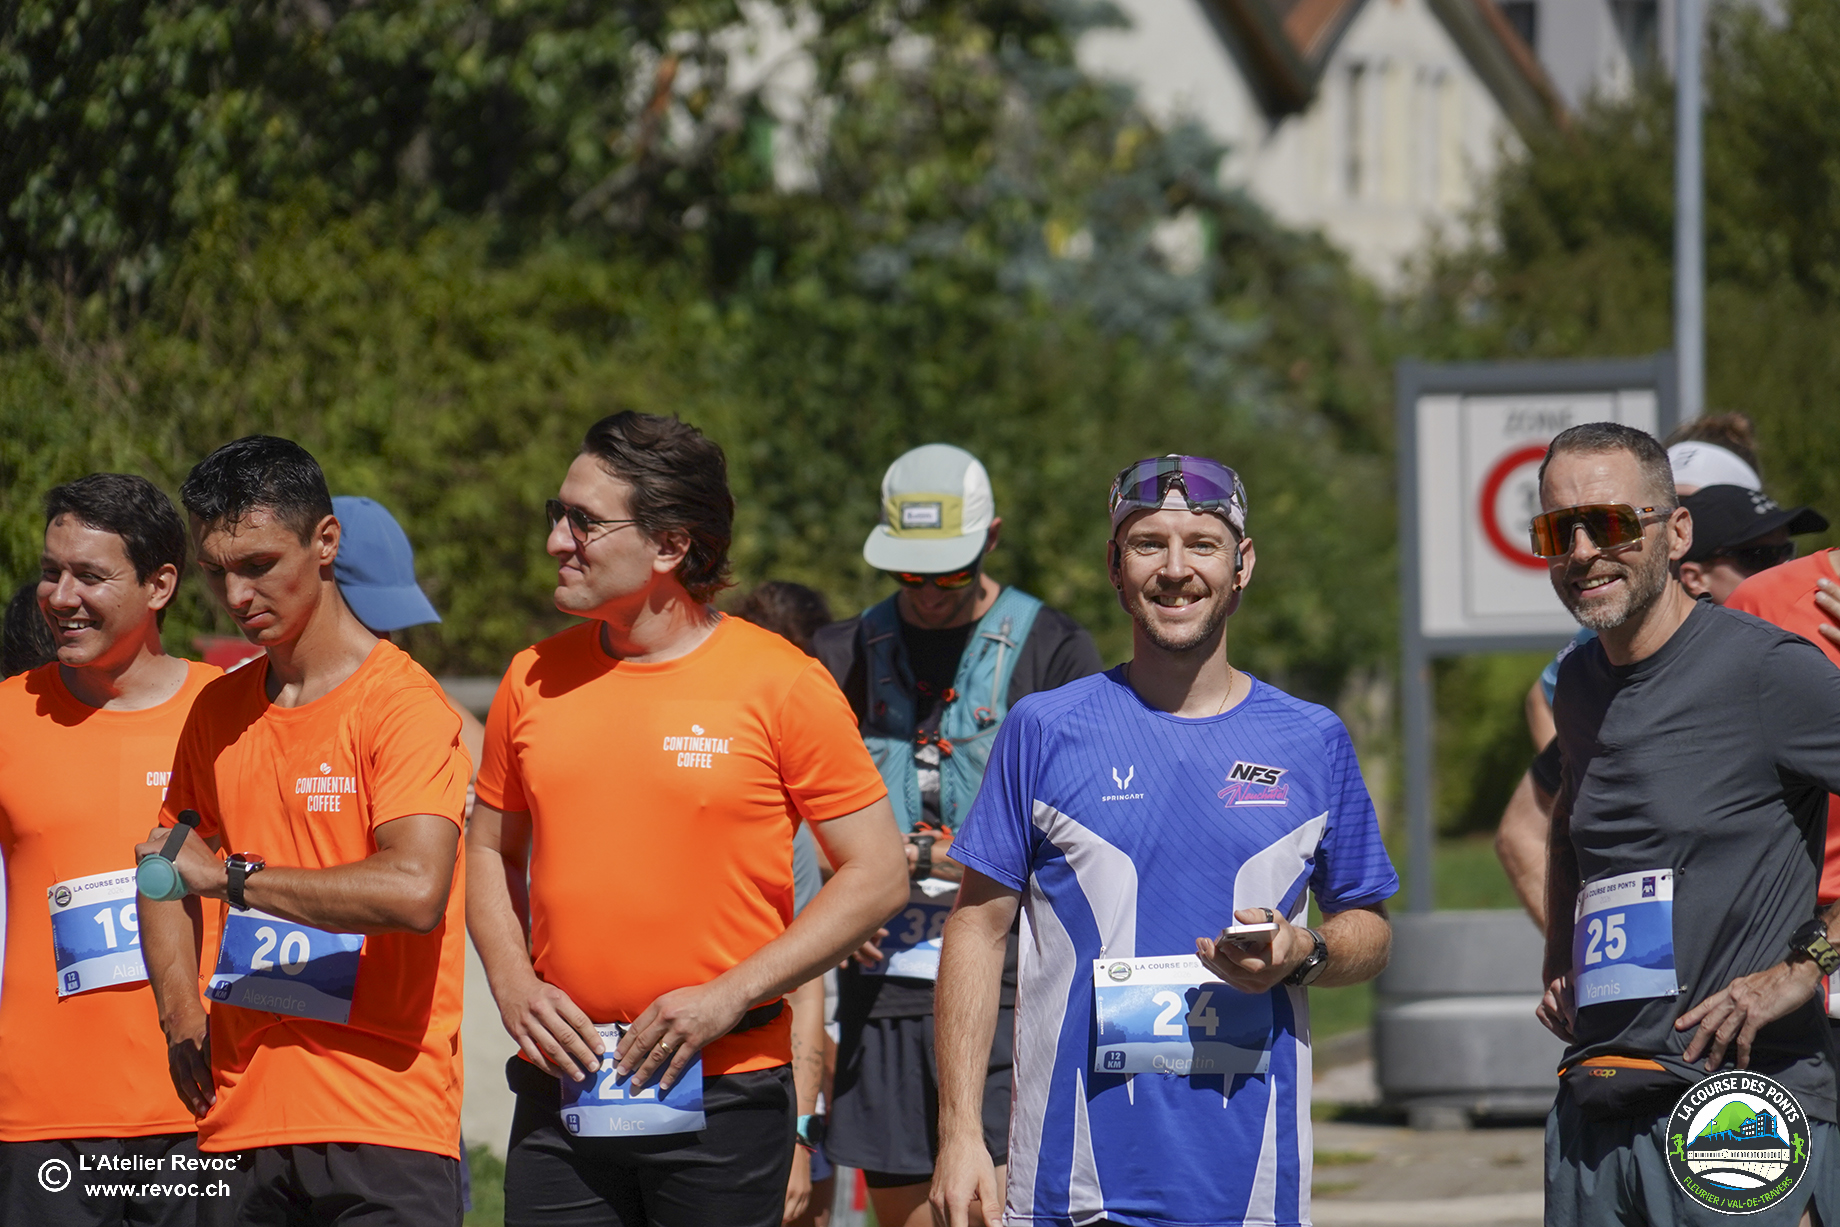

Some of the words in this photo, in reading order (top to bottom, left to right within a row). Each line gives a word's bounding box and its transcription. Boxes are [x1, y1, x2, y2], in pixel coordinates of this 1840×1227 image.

[663, 736, 729, 754] CONTINENTAL
[677, 752, 712, 768] COFFEE
[1230, 763, 1281, 785] NFS
[295, 776, 357, 794] CONTINENTAL
[307, 795, 341, 812] COFFEE
[1101, 793, 1144, 802] SPRINGART
[73, 885, 83, 893] LA
[84, 879, 113, 890] COURSE
[1588, 887, 1606, 898] COURSE
[1607, 884, 1617, 893] DES
[1617, 880, 1636, 890] PONTS
[93, 903, 140, 949] 19
[900, 908, 948, 948] 38
[1585, 913, 1627, 966] 25
[250, 926, 311, 976] 20
[67, 972, 76, 981] 12
[214, 989, 228, 999] KM
[219, 981, 229, 991] 12
[1586, 979, 1620, 999] Yannis
[242, 988, 306, 1011] Alexandre
[1152, 990, 1219, 1036] 24
[598, 1030, 619, 1038] OURS
[1110, 1052, 1121, 1060] 12
[1152, 1054, 1215, 1070] Quentin
[1107, 1060, 1122, 1069] KM
[568, 1115, 577, 1123] 12
[609, 1117, 646, 1131] Marc
